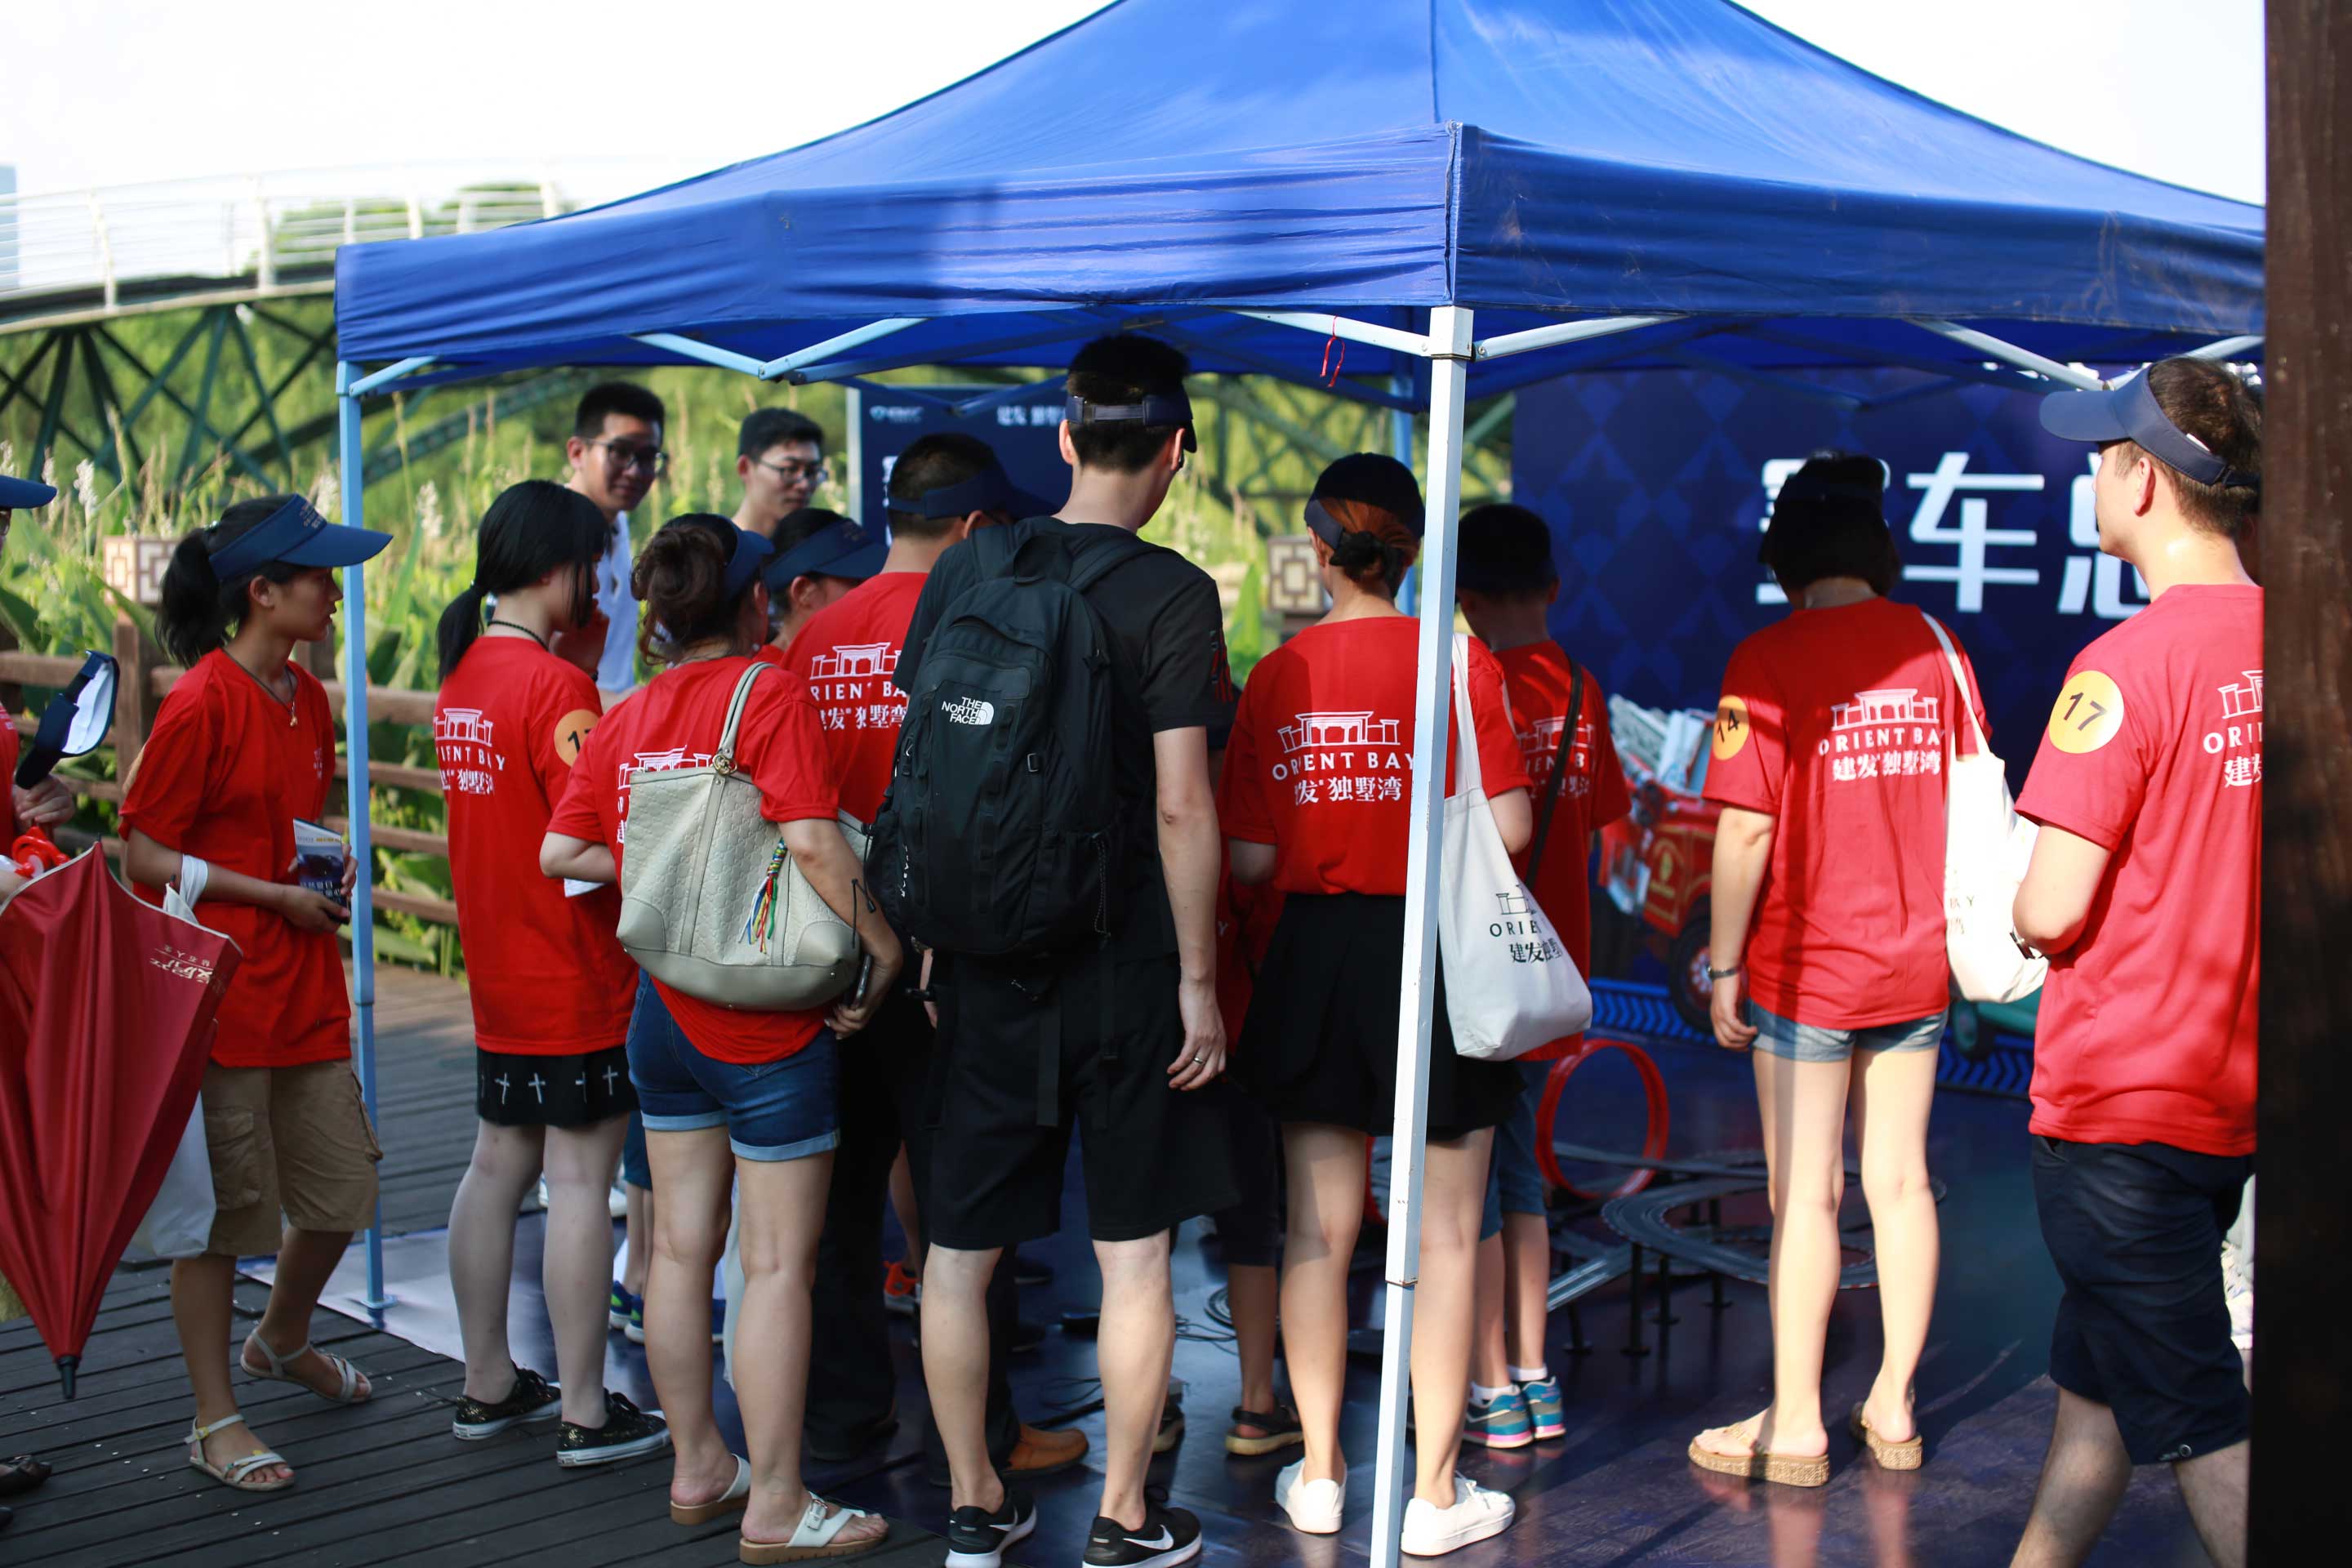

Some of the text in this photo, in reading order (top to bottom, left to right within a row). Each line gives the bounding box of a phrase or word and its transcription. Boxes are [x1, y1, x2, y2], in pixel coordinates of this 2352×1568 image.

[810, 680, 907, 702] RIEN BA
[961, 697, 982, 710] THE
[941, 701, 982, 718] NORTH
[950, 713, 978, 725] FACE
[2063, 692, 2108, 731] 17
[1717, 709, 1740, 743] 14
[2203, 722, 2262, 754] ORI
[568, 728, 590, 754] 1
[1818, 727, 1944, 756] ORIENT BA
[1294, 776, 1402, 806] 发独墅湾
[1490, 920, 1542, 938] ORIE
